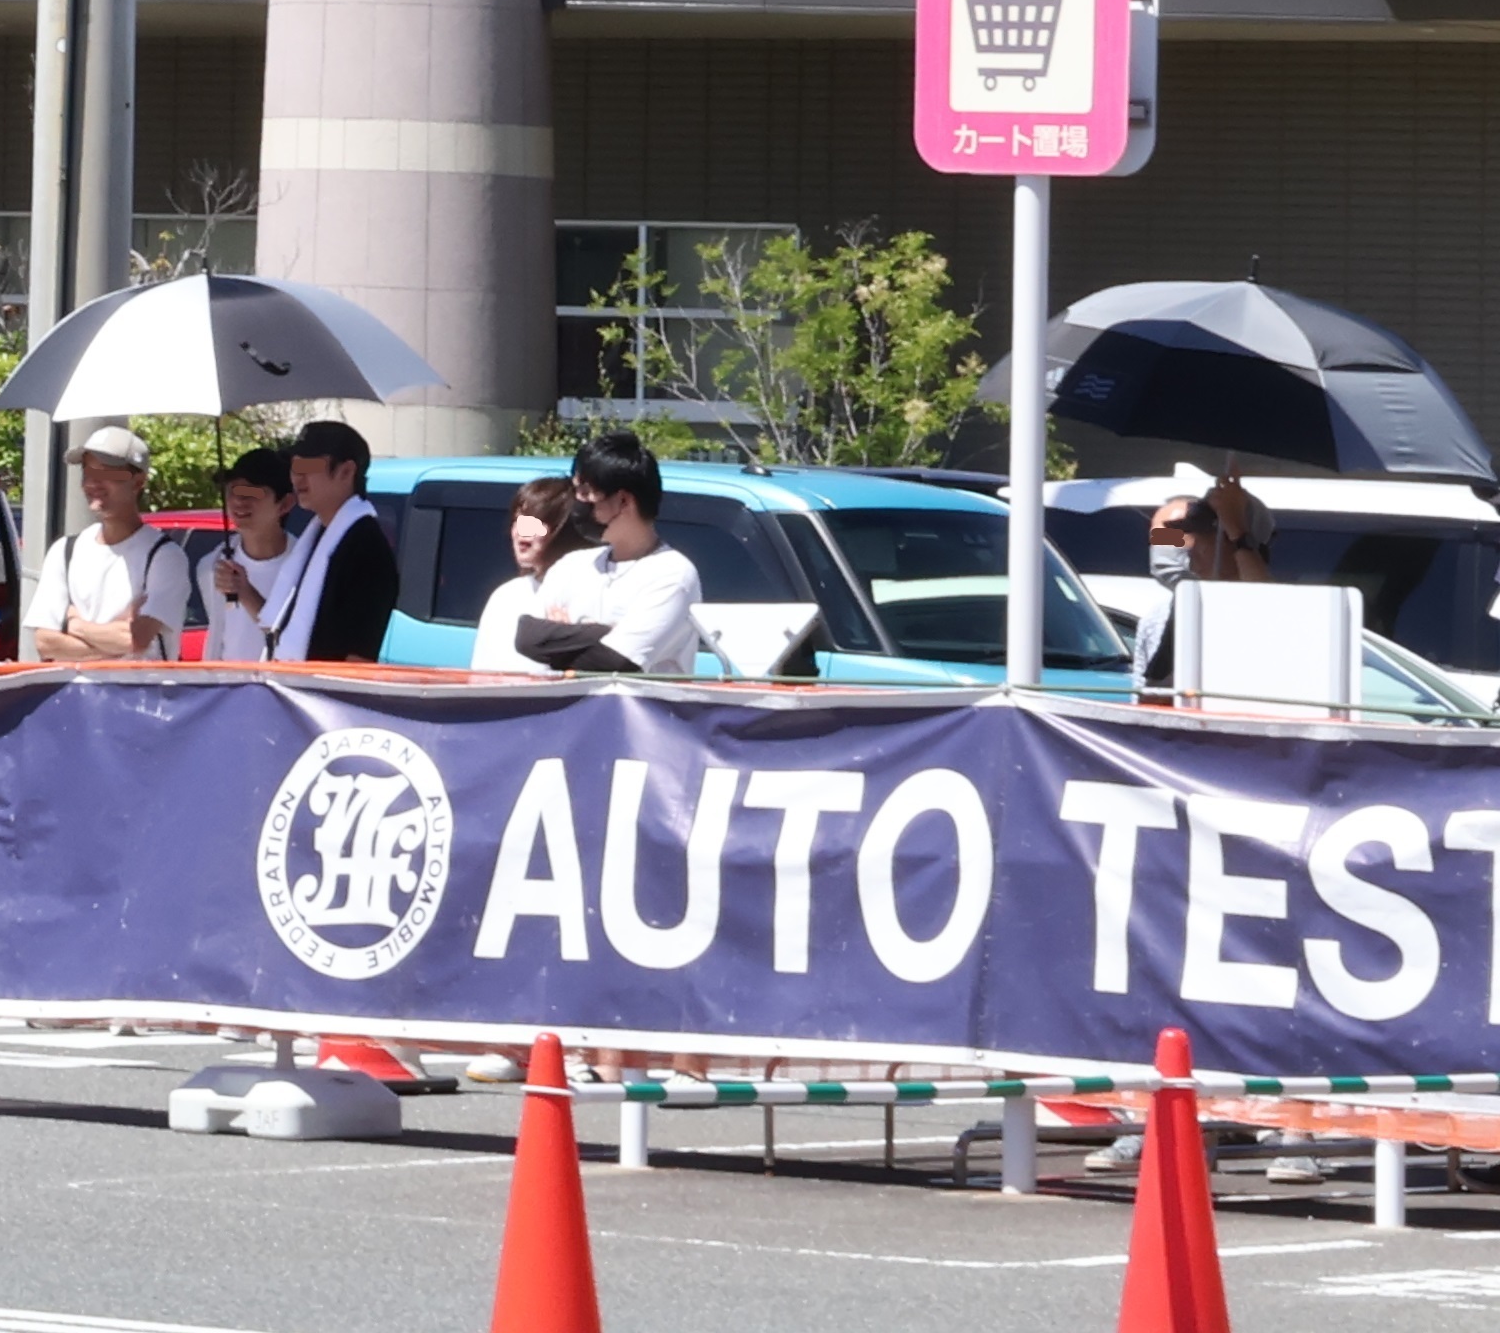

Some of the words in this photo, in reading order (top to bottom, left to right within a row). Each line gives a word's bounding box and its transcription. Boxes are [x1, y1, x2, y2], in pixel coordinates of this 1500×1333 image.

[952, 123, 1089, 159] カート置場
[319, 733, 416, 766] JAPAN
[264, 790, 336, 969] FEDERATION
[365, 794, 446, 971] AUTOMOBILE
[473, 757, 994, 984] AUTO
